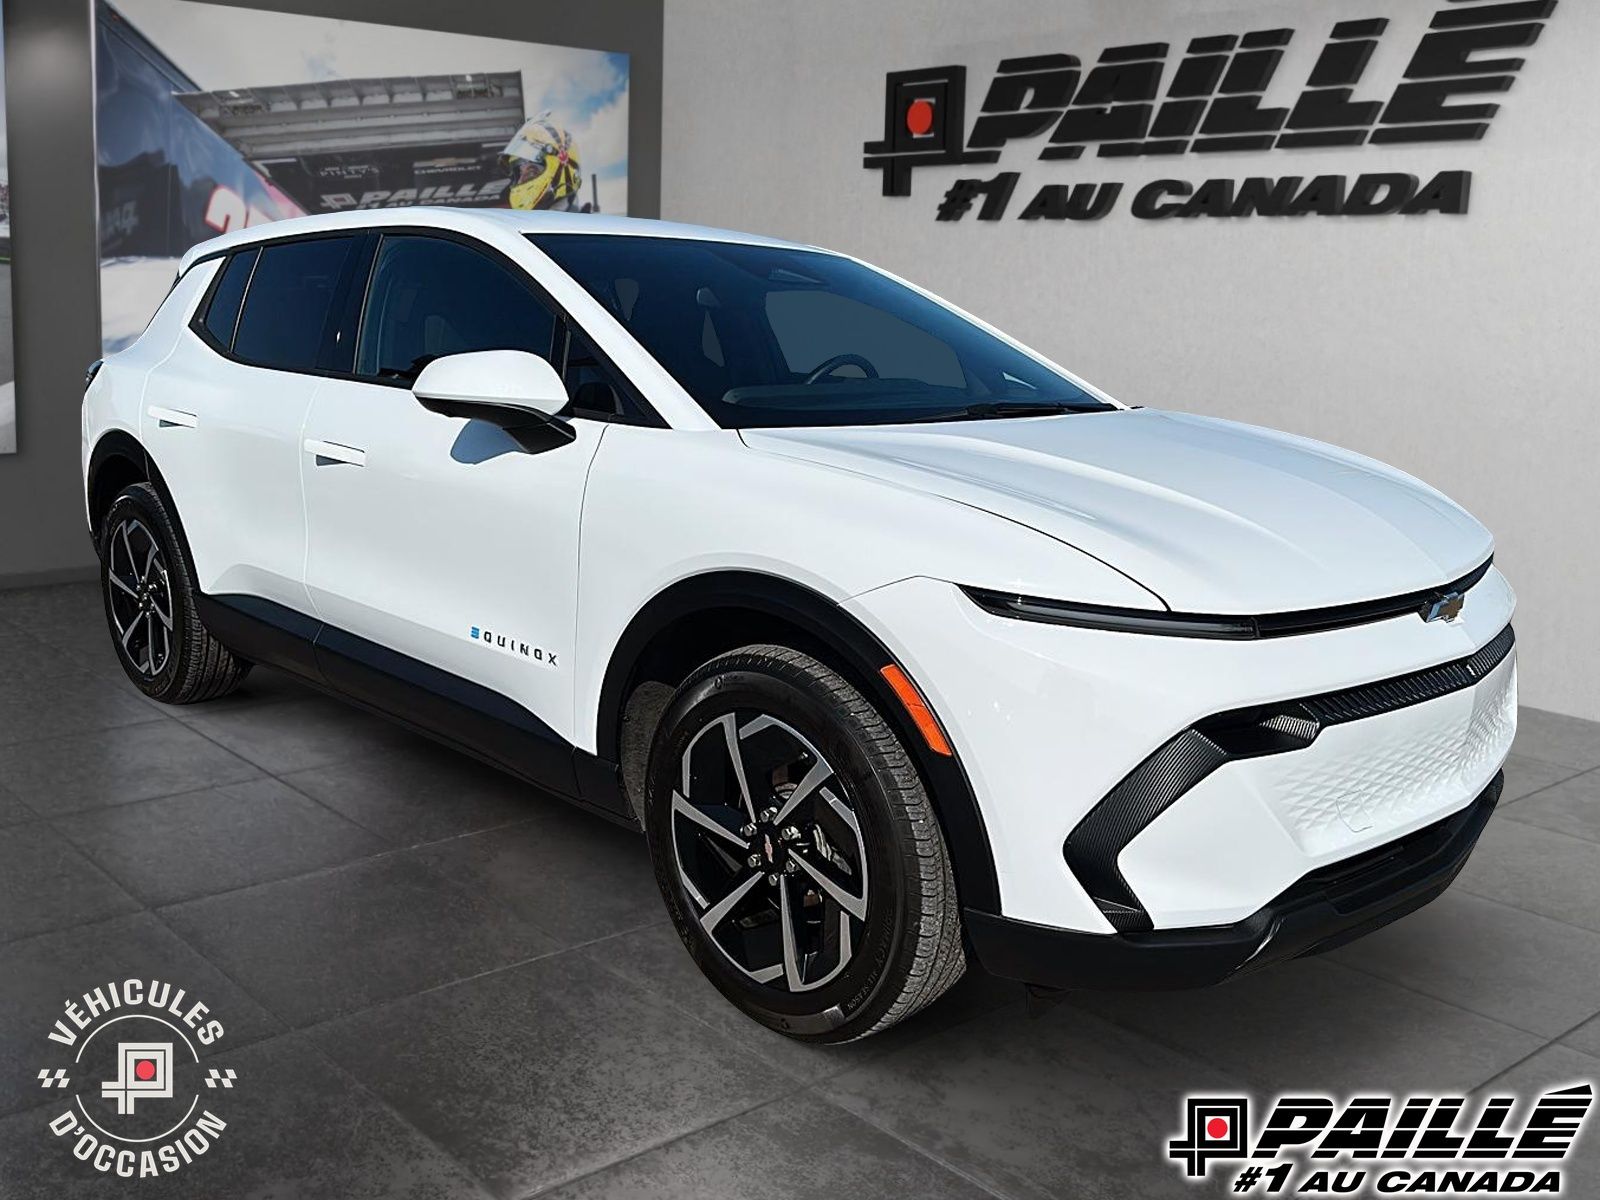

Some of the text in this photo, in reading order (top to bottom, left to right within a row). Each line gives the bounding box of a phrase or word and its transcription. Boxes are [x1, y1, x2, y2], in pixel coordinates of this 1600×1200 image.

[419, 194, 501, 206] CANADA
[936, 170, 1473, 222] #1 AU CANADA
[470, 626, 558, 667] EQUINOX
